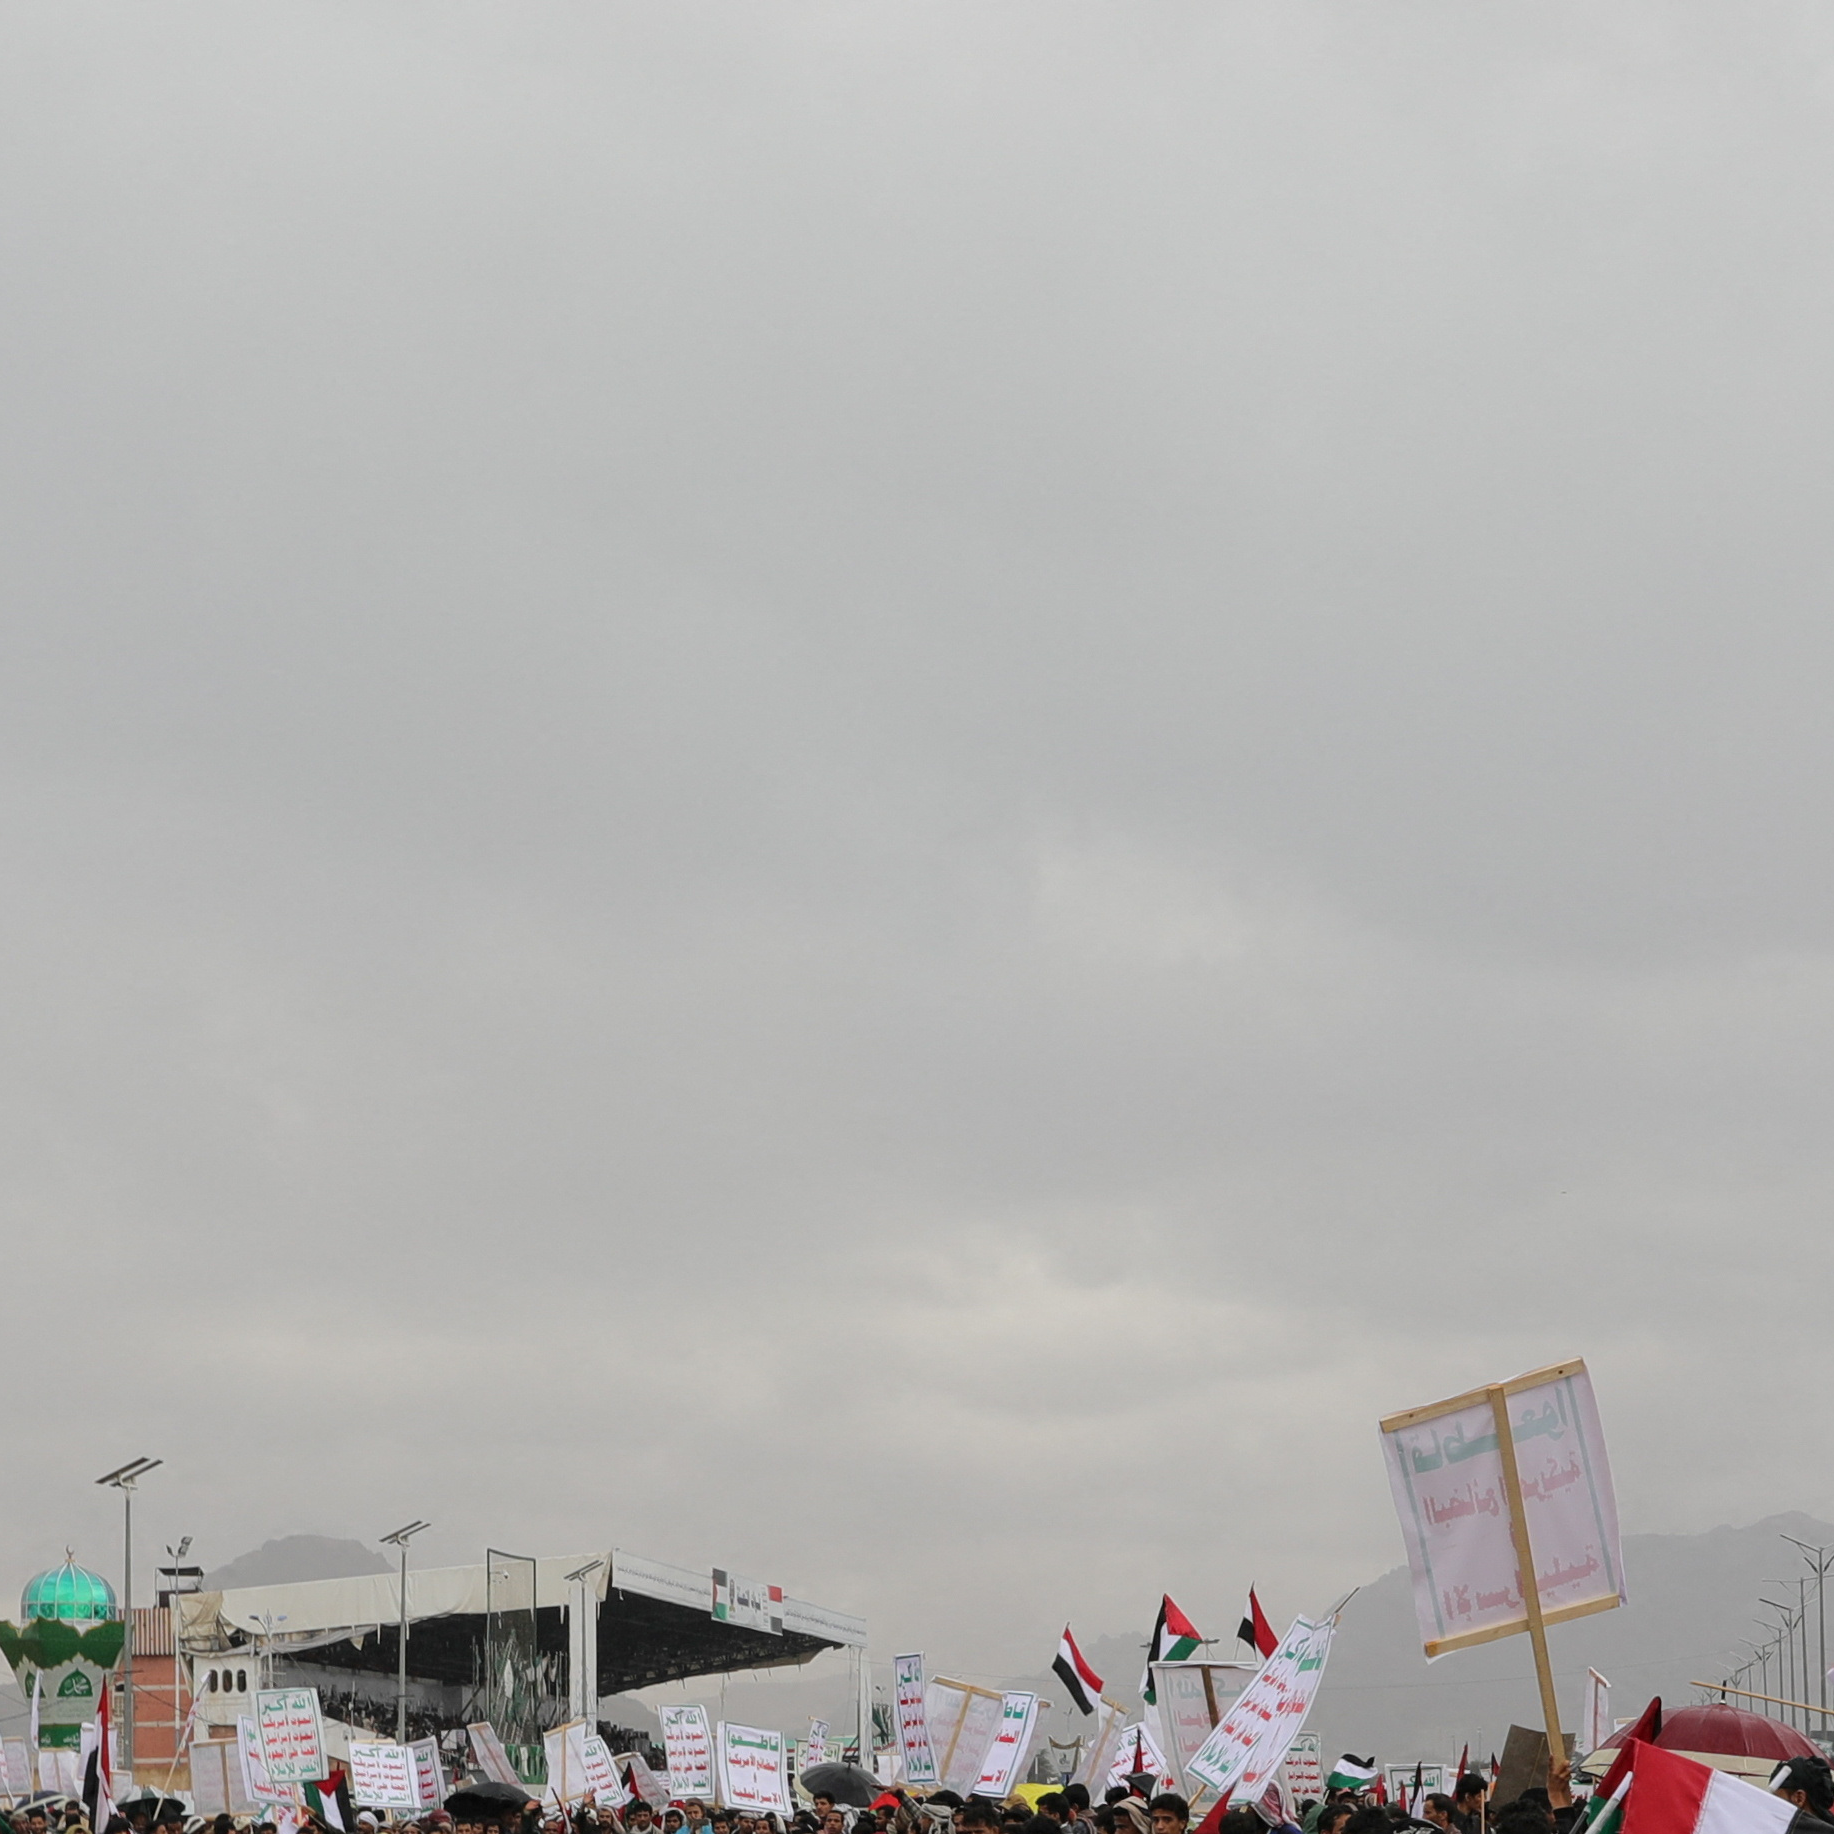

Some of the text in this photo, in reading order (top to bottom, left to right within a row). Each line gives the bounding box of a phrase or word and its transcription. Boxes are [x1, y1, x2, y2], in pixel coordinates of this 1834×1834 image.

[262, 1694, 311, 1715] الله أكبر
[291, 1715, 314, 1728] الموت
[685, 1712, 702, 1725] الله
[293, 1732, 316, 1743] الموت
[685, 1732, 705, 1740] الموت
[728, 1730, 779, 1752] قاطعوا
[353, 1745, 404, 1759] الله أكبر
[585, 1744, 602, 1757] الله
[688, 1747, 709, 1756] الموت
[586, 1760, 605, 1770] الموت
[729, 1751, 779, 1772] البضائع الأمريكية
[590, 1770, 610, 1781] الموت
[732, 1786, 782, 1805] الإسرائيلية
